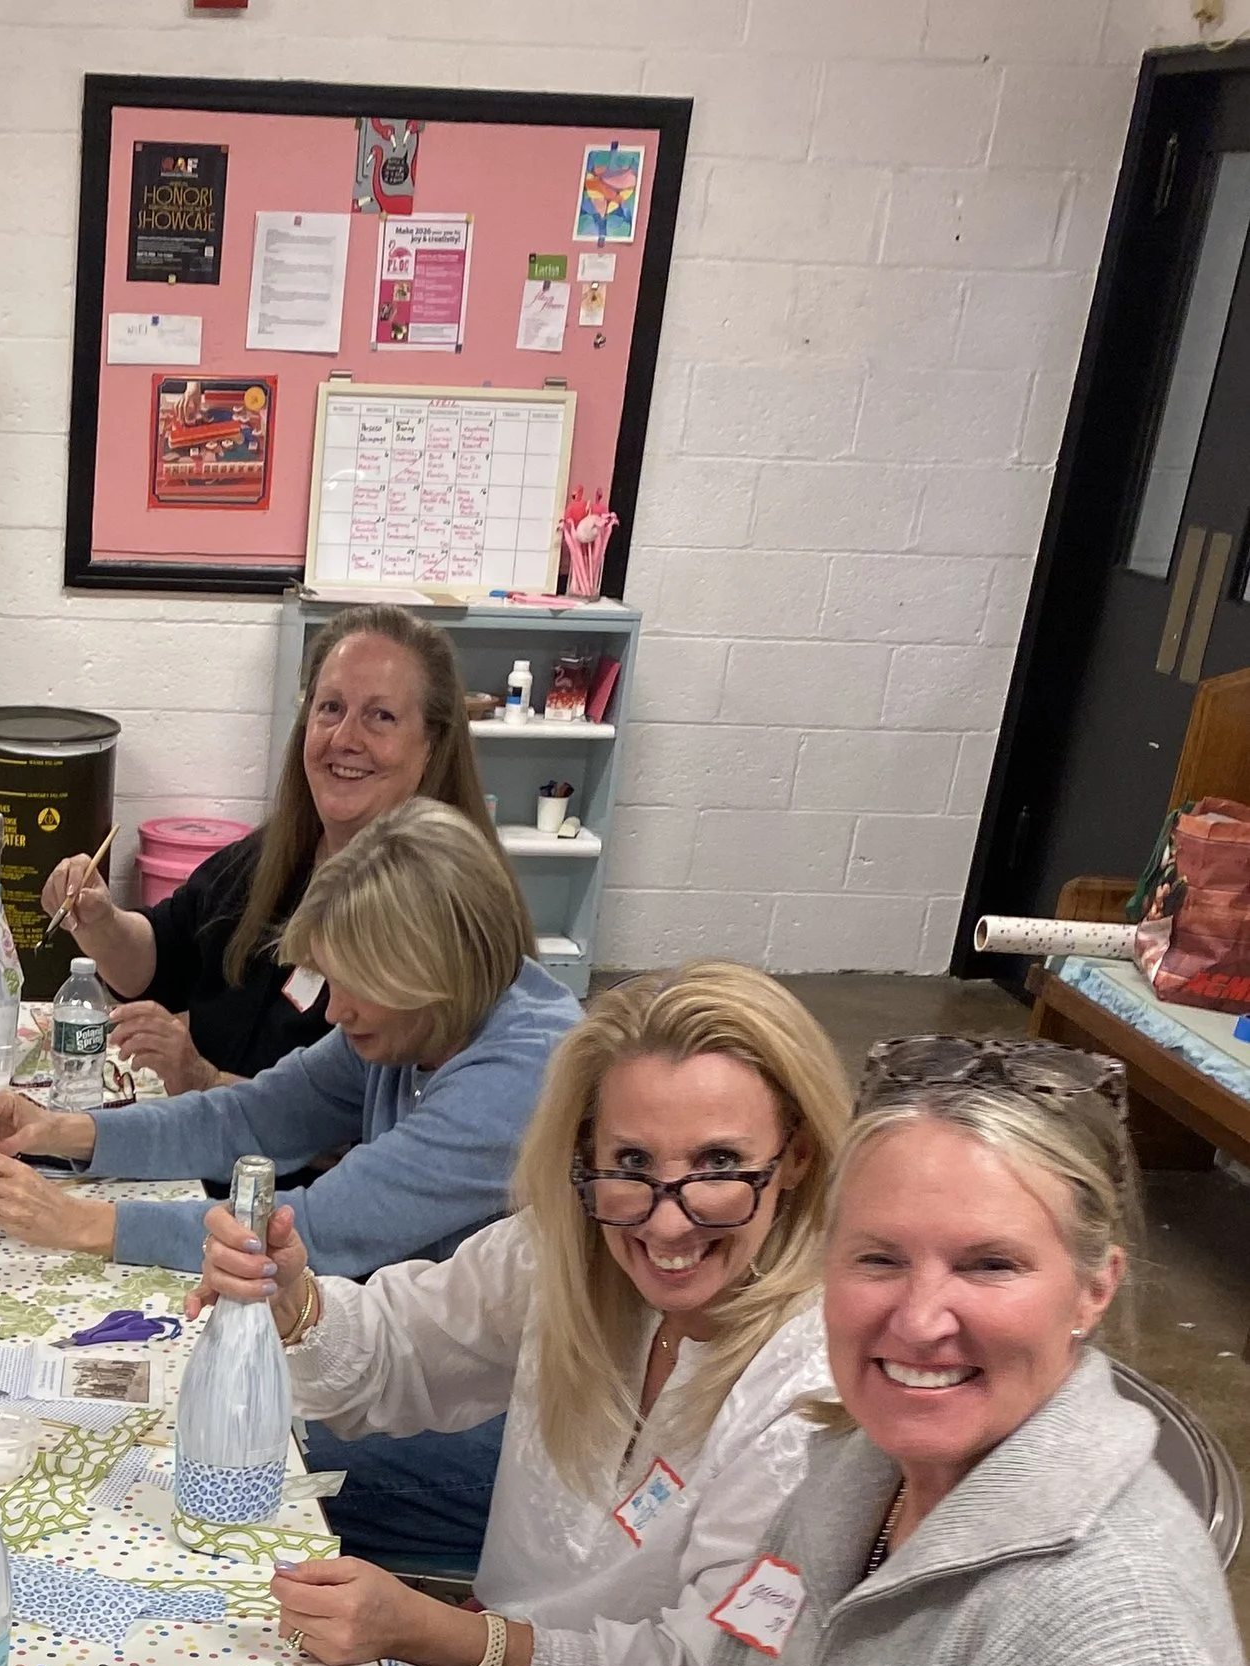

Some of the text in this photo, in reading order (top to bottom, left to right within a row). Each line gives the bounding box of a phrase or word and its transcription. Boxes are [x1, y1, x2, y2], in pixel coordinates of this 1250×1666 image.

[143, 185, 214, 207] HONORS
[137, 209, 216, 232] SHOWCASE
[3, 833, 26, 846] ATER
[76, 1025, 104, 1041] Poland
[76, 1036, 104, 1050] Spring
